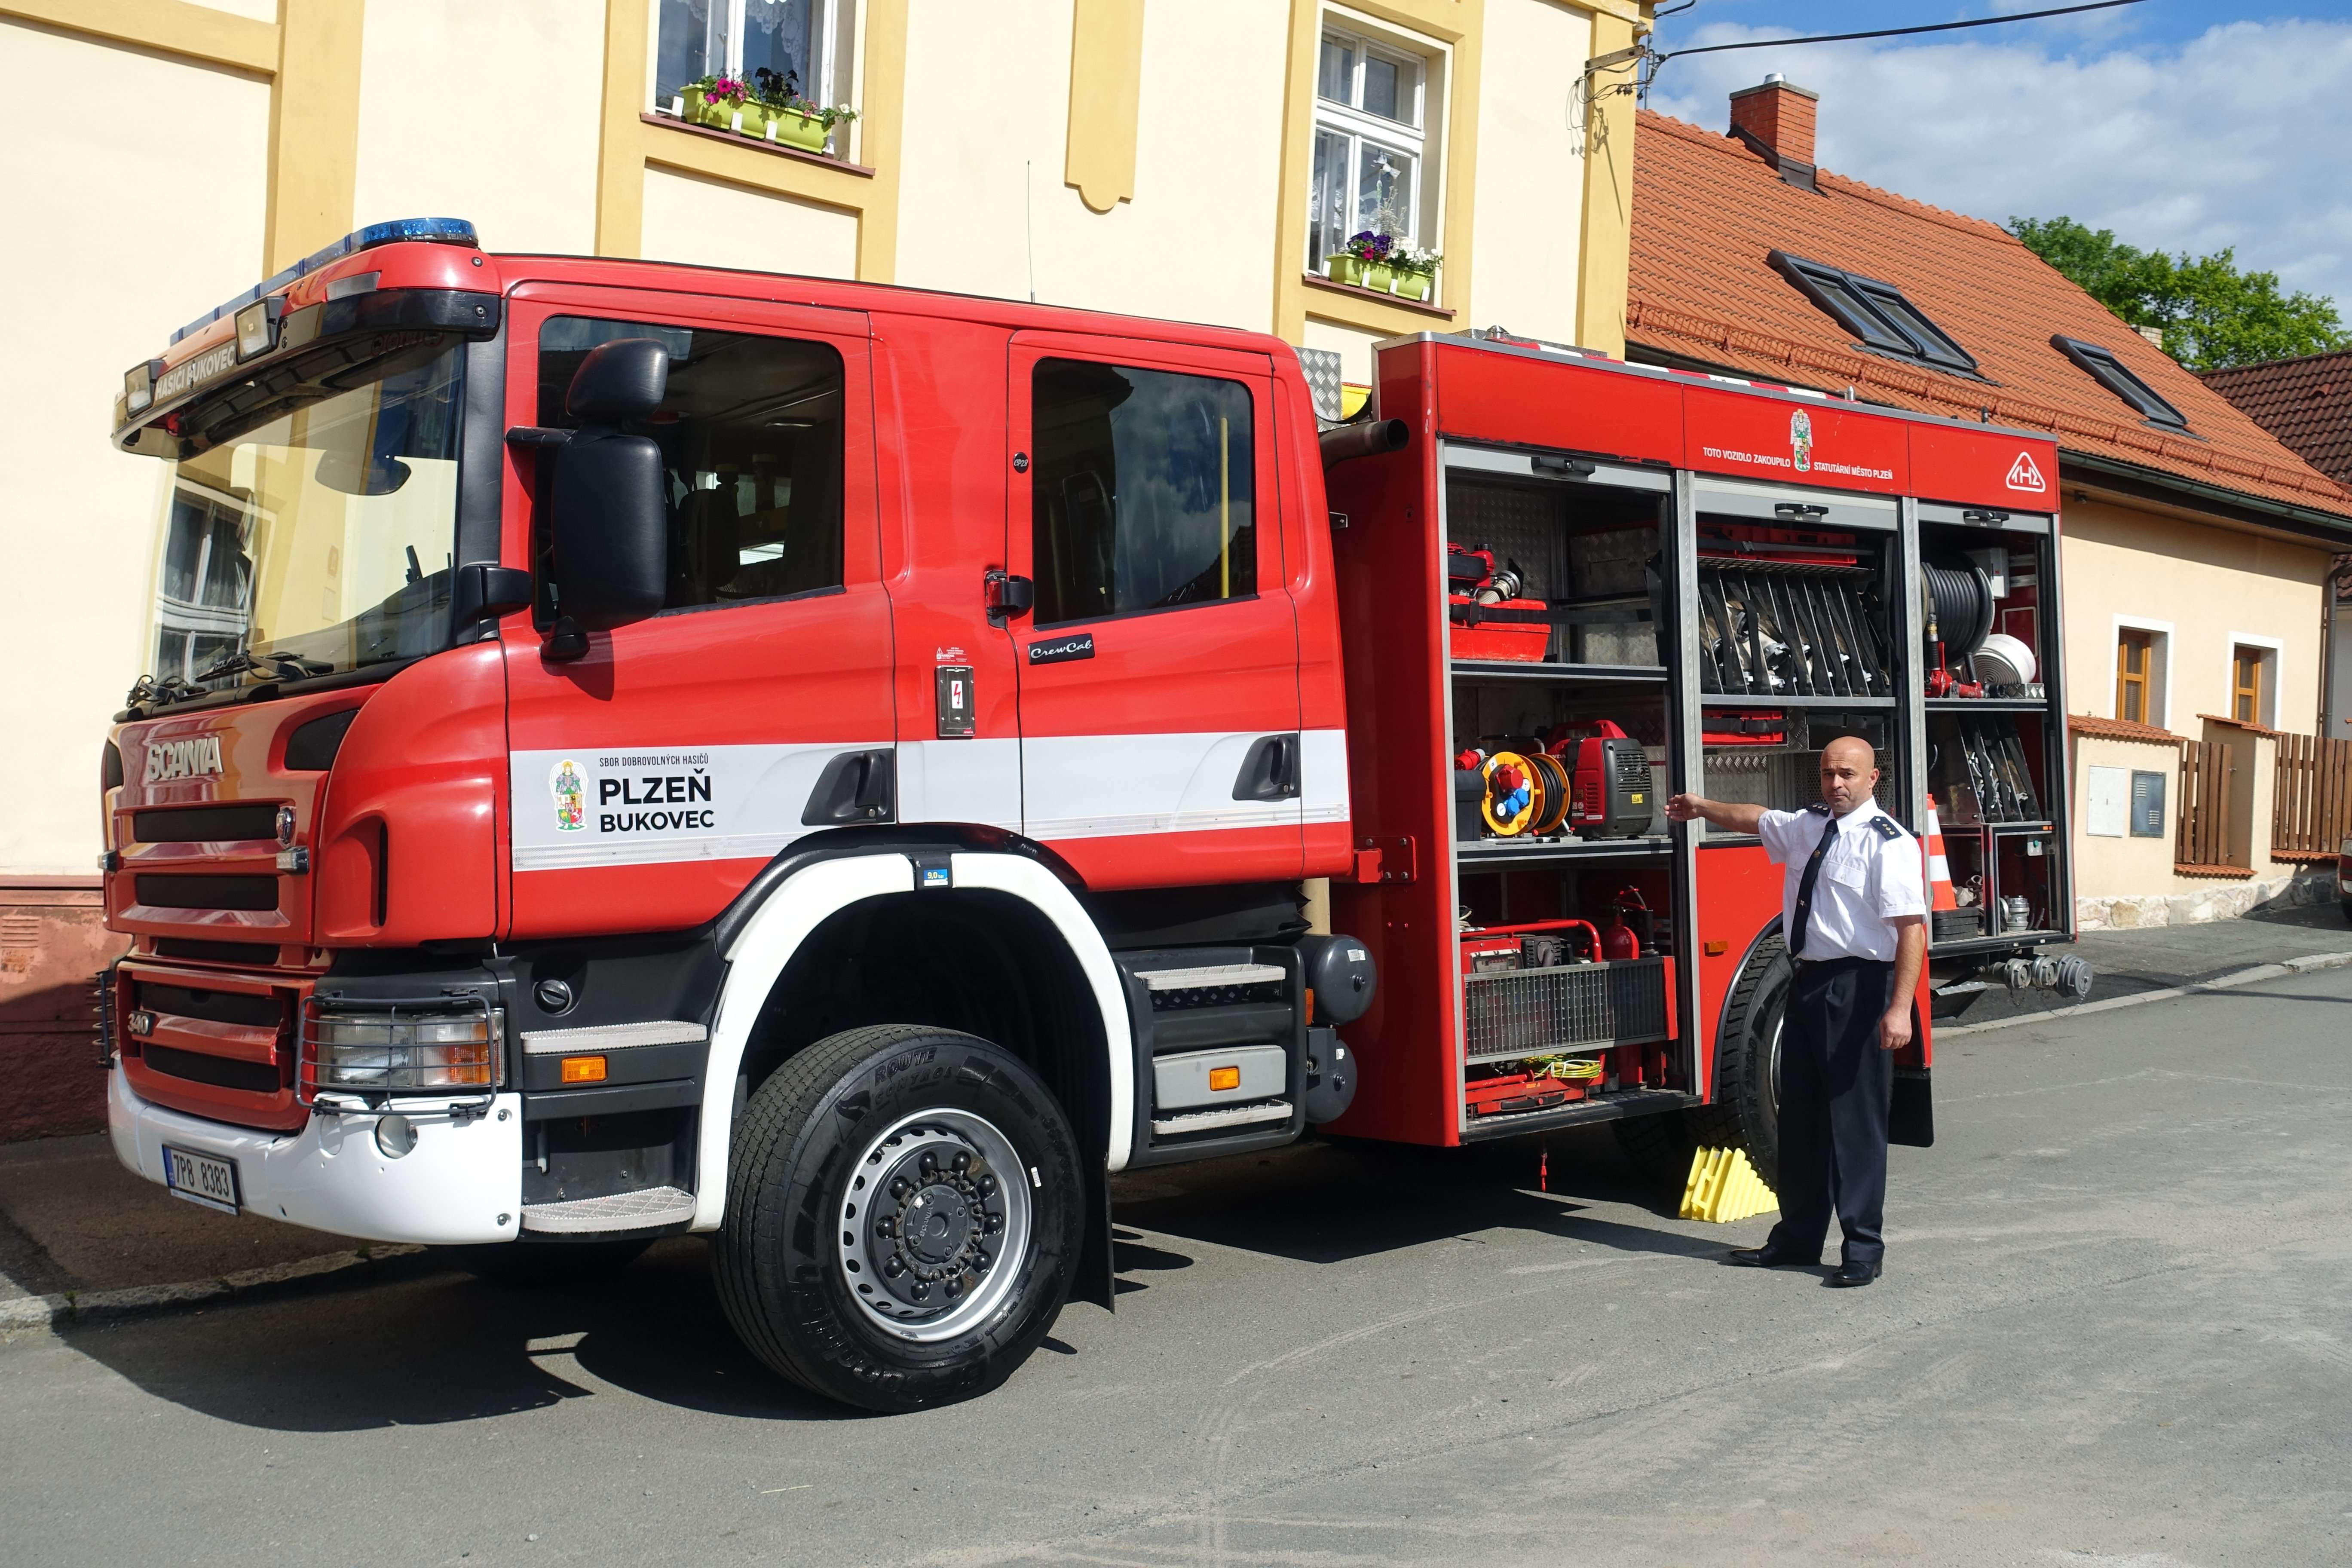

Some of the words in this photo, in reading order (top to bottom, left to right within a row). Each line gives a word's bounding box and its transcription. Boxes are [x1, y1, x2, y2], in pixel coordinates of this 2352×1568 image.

[155, 365, 185, 401] HASIČI
[186, 345, 235, 386] BUKOVEC
[1014, 459, 1028, 467] CP28
[1703, 447, 1721, 459] TOTO
[1722, 450, 1752, 462] VOZIDLO
[1753, 454, 1791, 468] ZAKOUPILO
[1814, 462, 1850, 475] STATUTÁRNÍ
[1851, 466, 1873, 478] MĚSTO
[1873, 469, 1893, 480] PLZEŇ
[1031, 640, 1092, 658] CrewCab
[147, 737, 223, 780] SCANIA
[599, 757, 619, 767] SBOR
[622, 754, 680, 766] DOBROVOLNÝCH
[683, 753, 709, 765] HASIČŮ
[600, 768, 712, 806] PLZEŇ
[600, 810, 715, 833] BUKOVEC
[927, 871, 938, 879] 9,0
[127, 1013, 149, 1035] 340
[874, 1047, 938, 1087] ROUTE
[173, 1154, 195, 1187] 7P8
[201, 1162, 230, 1197] 8383
[920, 1206, 934, 1237] SCANIA
